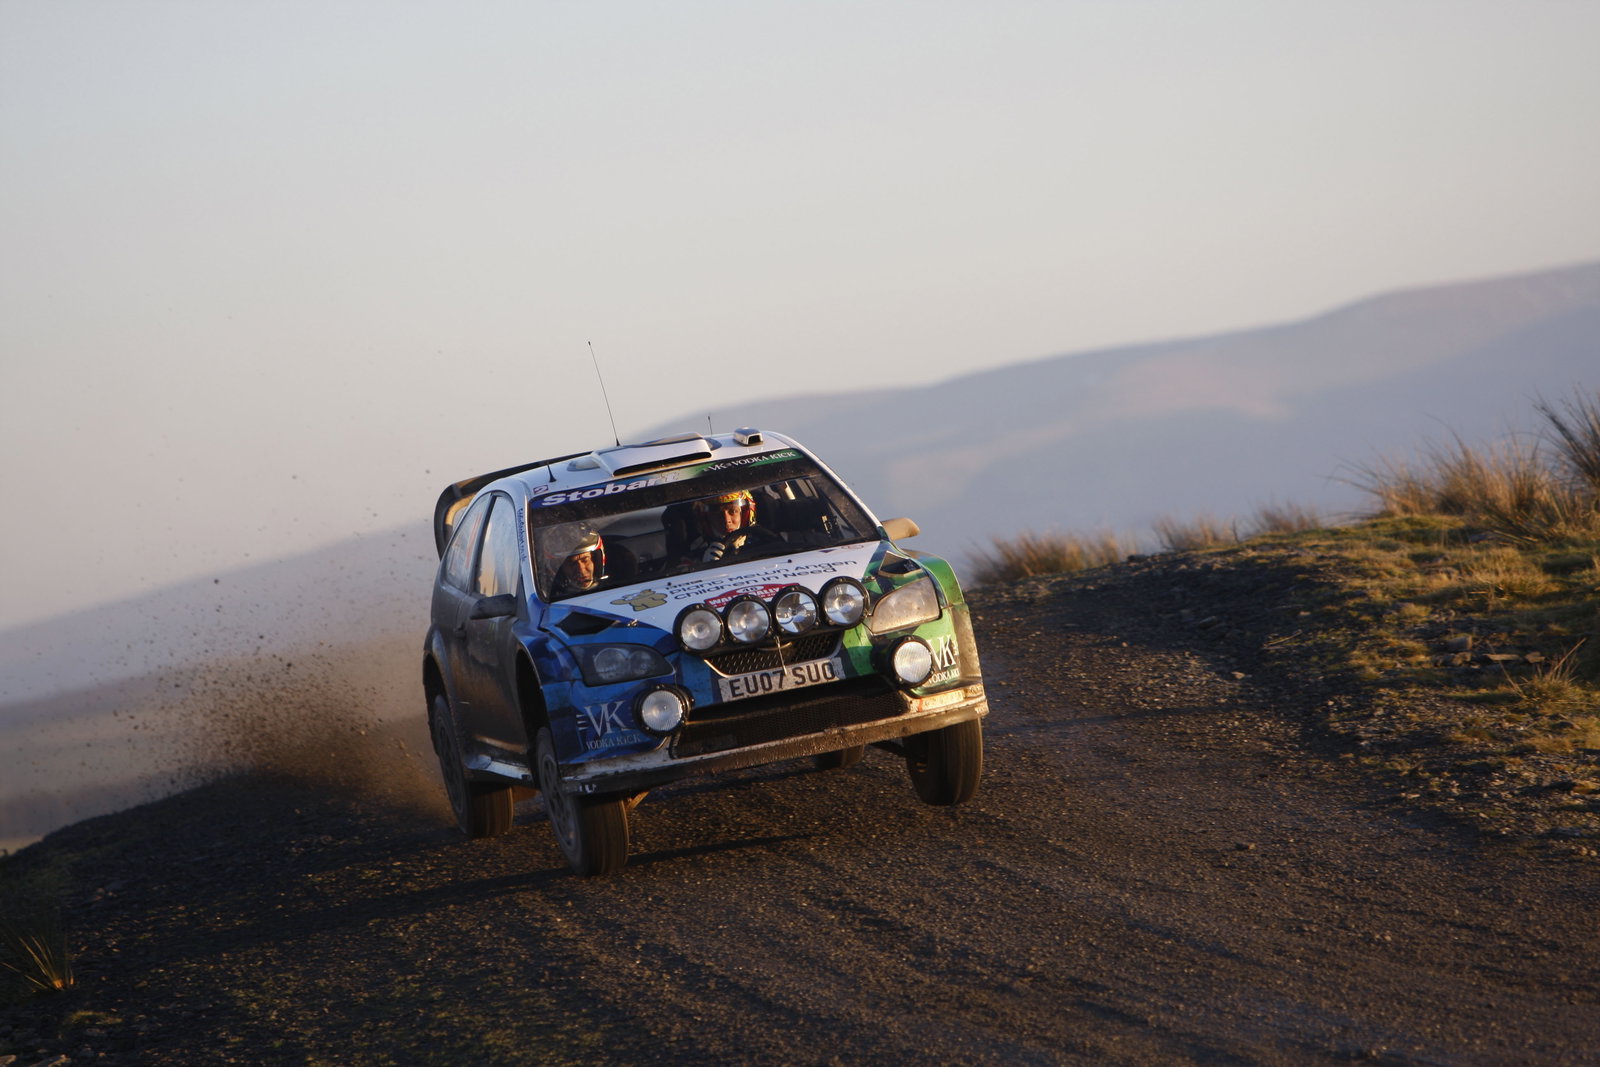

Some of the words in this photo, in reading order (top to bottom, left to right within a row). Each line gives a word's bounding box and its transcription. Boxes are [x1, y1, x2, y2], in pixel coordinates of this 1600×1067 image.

[731, 455, 769, 466] VODKA
[769, 451, 797, 460] KICK
[541, 471, 680, 506] Stobart
[783, 567, 837, 578] Need
[708, 594, 740, 606] WAL
[925, 634, 957, 671] VK
[728, 669, 785, 698] EU07
[791, 662, 835, 686] SUO
[584, 700, 627, 738] VK
[586, 738, 615, 750] VODKA
[617, 733, 641, 745] KICK
